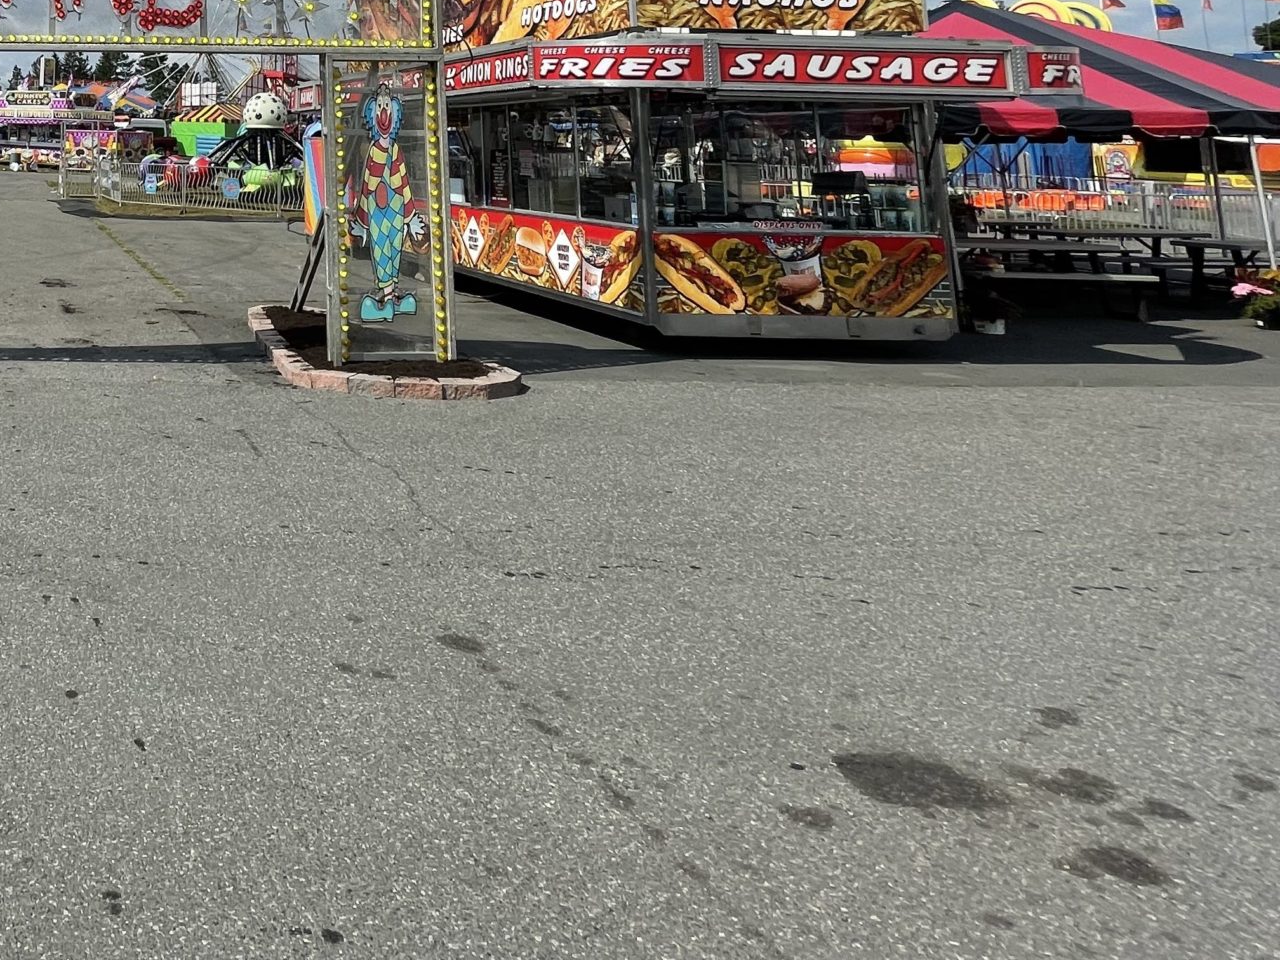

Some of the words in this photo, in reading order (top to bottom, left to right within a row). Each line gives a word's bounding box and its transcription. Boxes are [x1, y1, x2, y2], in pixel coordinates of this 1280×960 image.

[648, 47, 691, 55] CHEESE
[460, 61, 491, 84] ONION
[495, 54, 529, 80] RINGS
[539, 57, 691, 78] FRIES
[728, 52, 998, 83] SAUSAGE
[752, 220, 796, 230] DISPLAYS
[799, 221, 824, 230] ONLY
